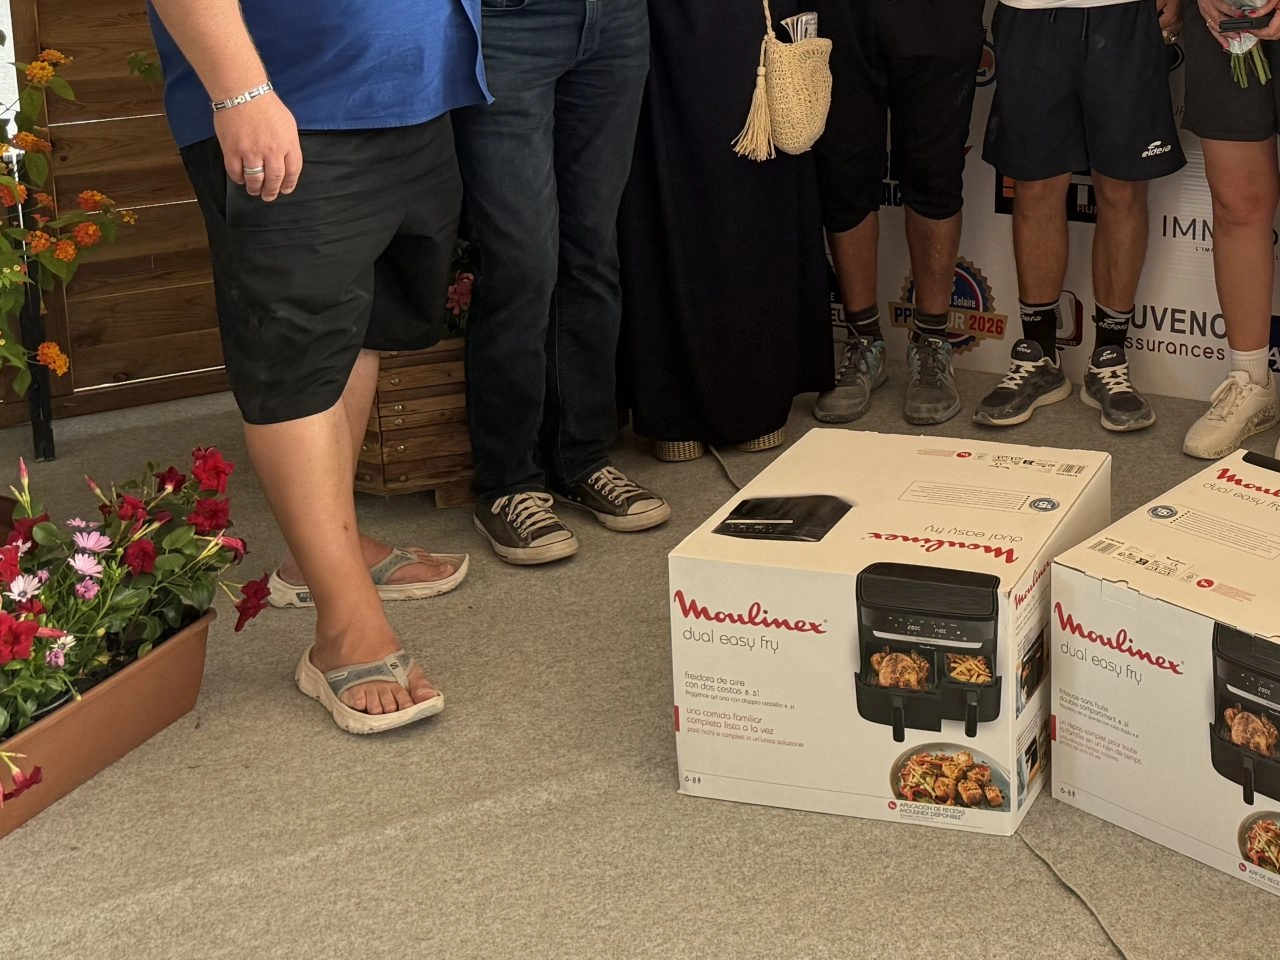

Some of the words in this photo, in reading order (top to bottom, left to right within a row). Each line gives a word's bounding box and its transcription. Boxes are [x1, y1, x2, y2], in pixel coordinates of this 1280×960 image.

[1141, 144, 1171, 158] eldera
[953, 296, 976, 308] Solaire
[969, 315, 1004, 335] 2026
[1124, 335, 1225, 361] ssurances
[1203, 482, 1230, 496] dual
[1233, 491, 1266, 507] easy
[924, 524, 945, 535] fry
[947, 528, 985, 538] easy
[989, 532, 1023, 544] dual
[866, 531, 1019, 564] Moulinex
[674, 590, 827, 634] Moulinex
[683, 627, 714, 643] dual
[720, 634, 755, 651] easy
[761, 636, 779, 654] fry
[1054, 602, 1184, 675] Moulinex
[1061, 641, 1087, 661] dual
[1092, 655, 1122, 677] easy
[1126, 664, 1142, 685] fry
[685, 671, 715, 683] freidora
[717, 675, 727, 684] de
[730, 679, 745, 687] aire
[685, 681, 698, 689] con
[701, 682, 715, 691] dos
[717, 685, 742, 695] cestas
[686, 707, 701, 715] una
[703, 709, 731, 720] comida
[733, 712, 762, 724] familiar
[687, 716, 722, 728] completa
[724, 721, 740, 731] lista
[750, 724, 758, 733] la
[761, 727, 774, 735] vez
